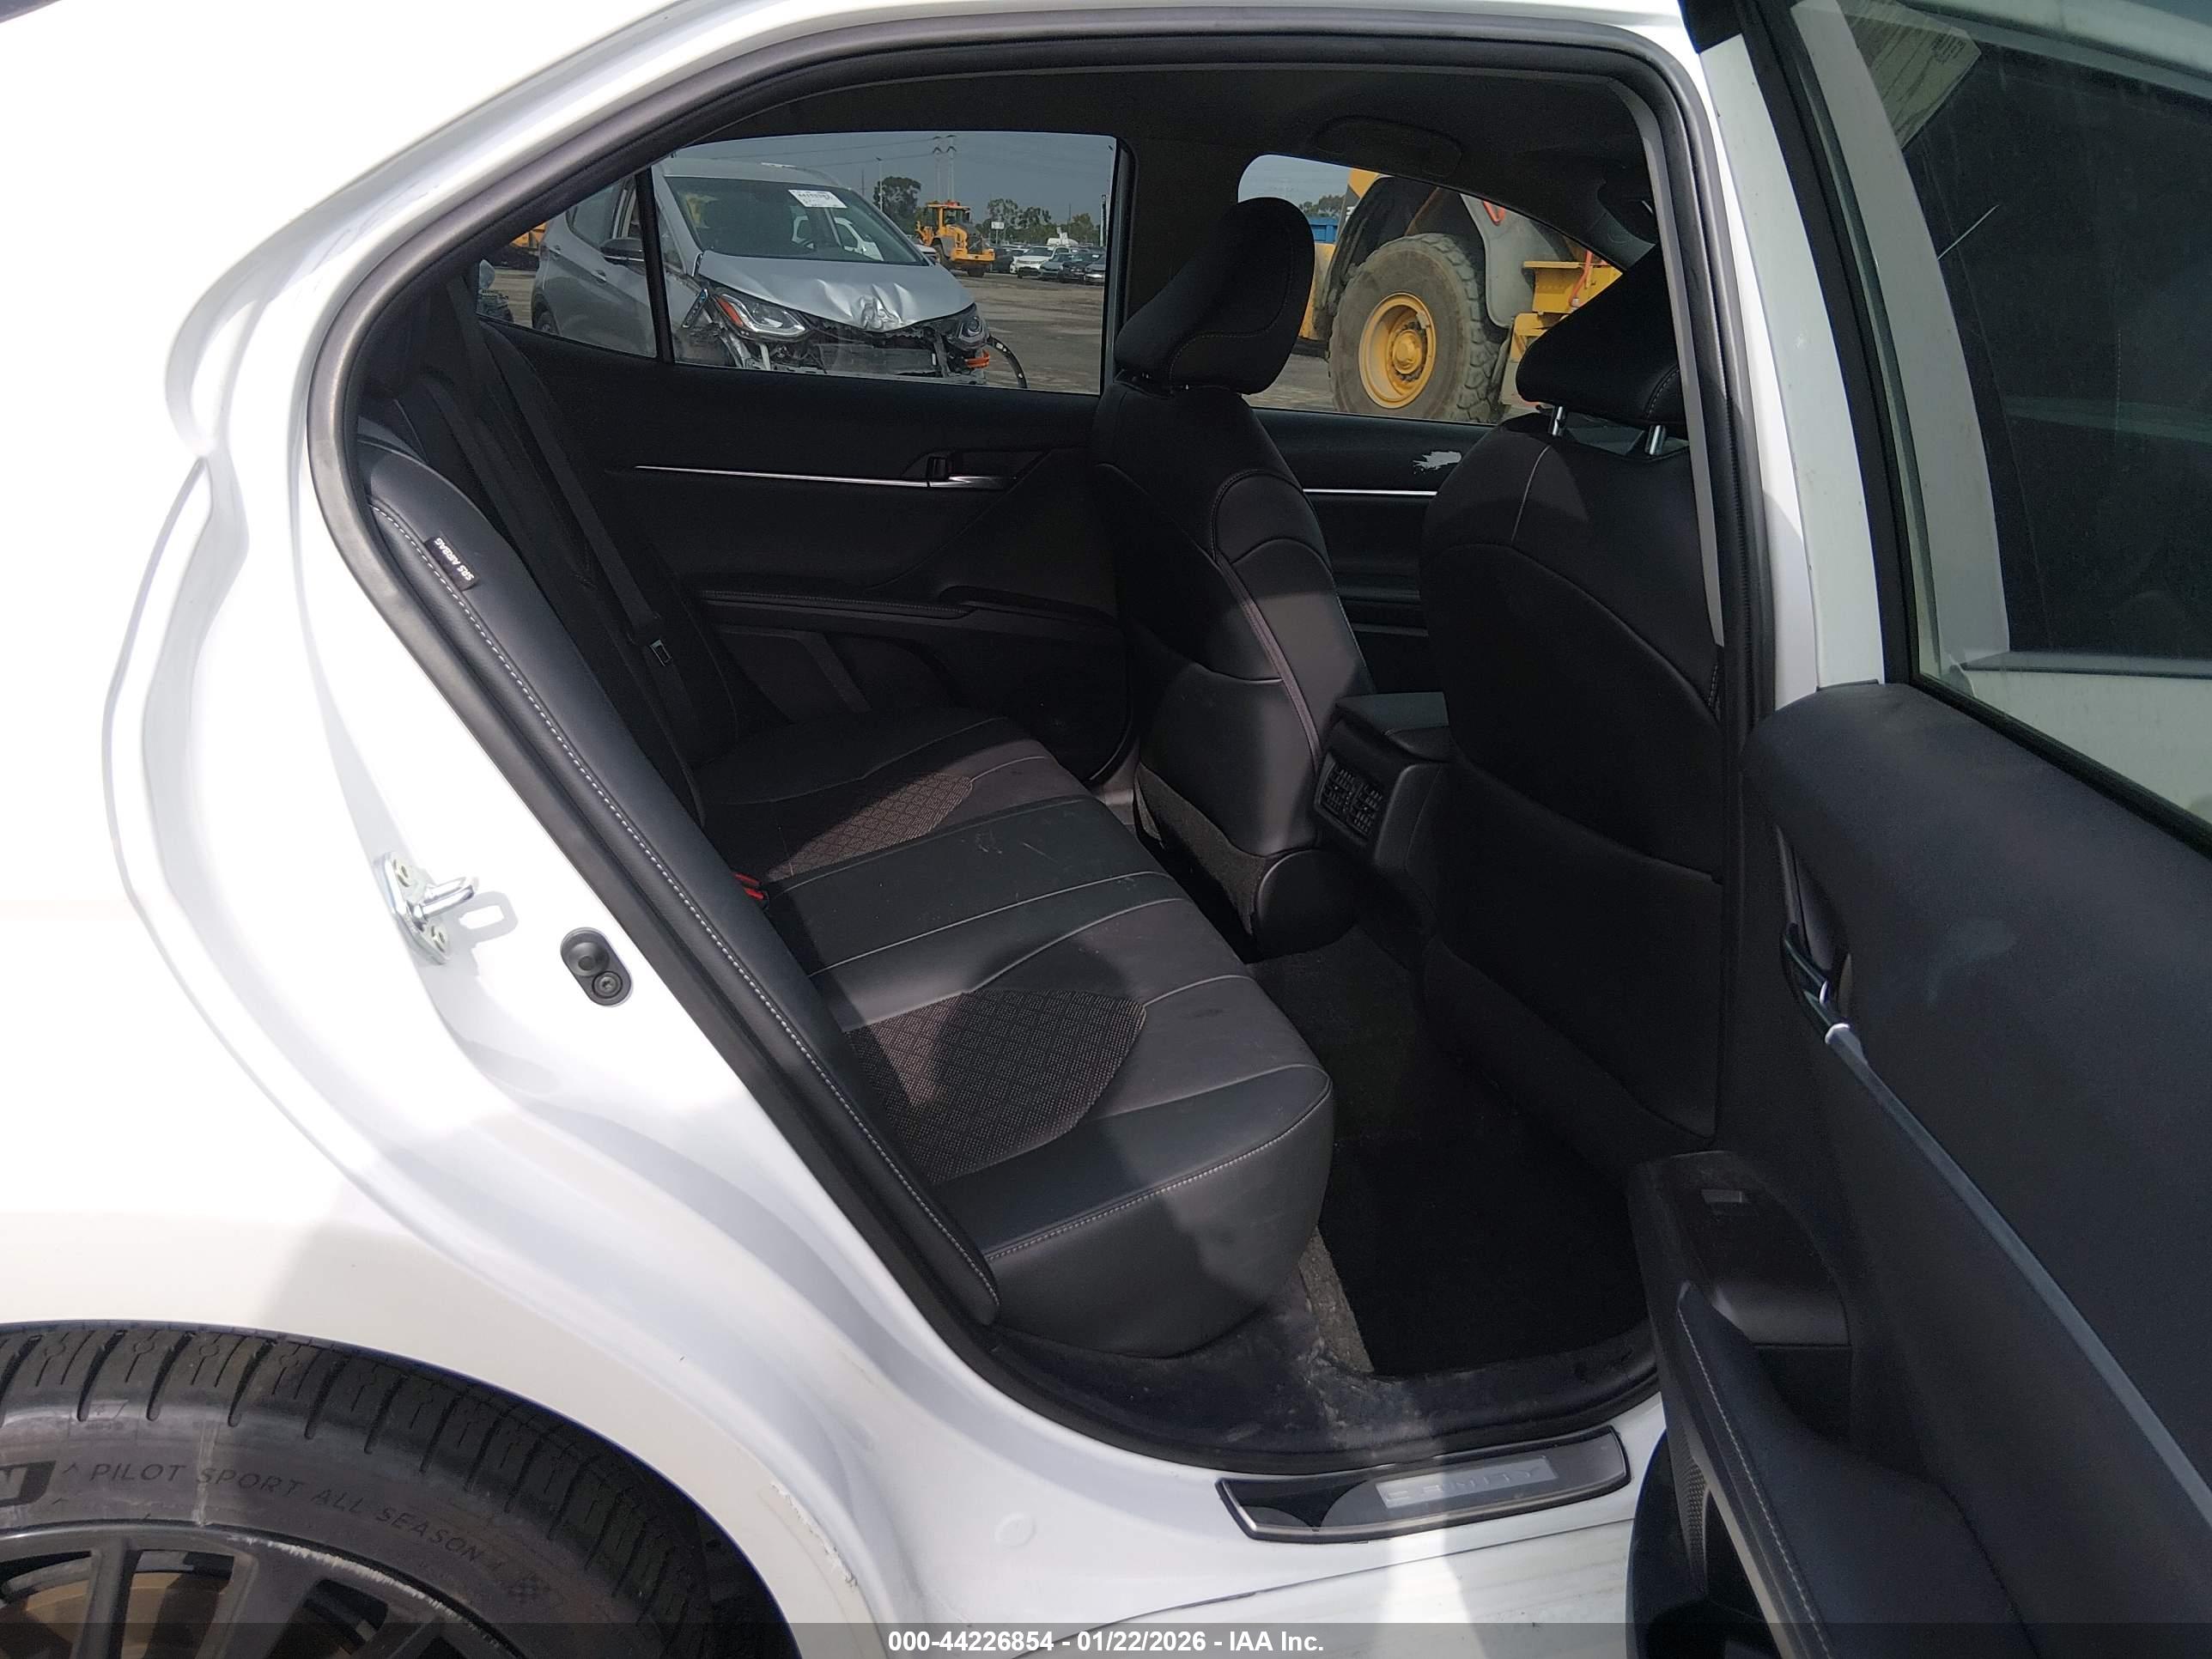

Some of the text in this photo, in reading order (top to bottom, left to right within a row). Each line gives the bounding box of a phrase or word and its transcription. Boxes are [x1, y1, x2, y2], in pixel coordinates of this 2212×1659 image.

[434, 537, 475, 581] SRS AIRBAG
[90, 1462, 486, 1563] PILOT SPORT ALL SEASON
